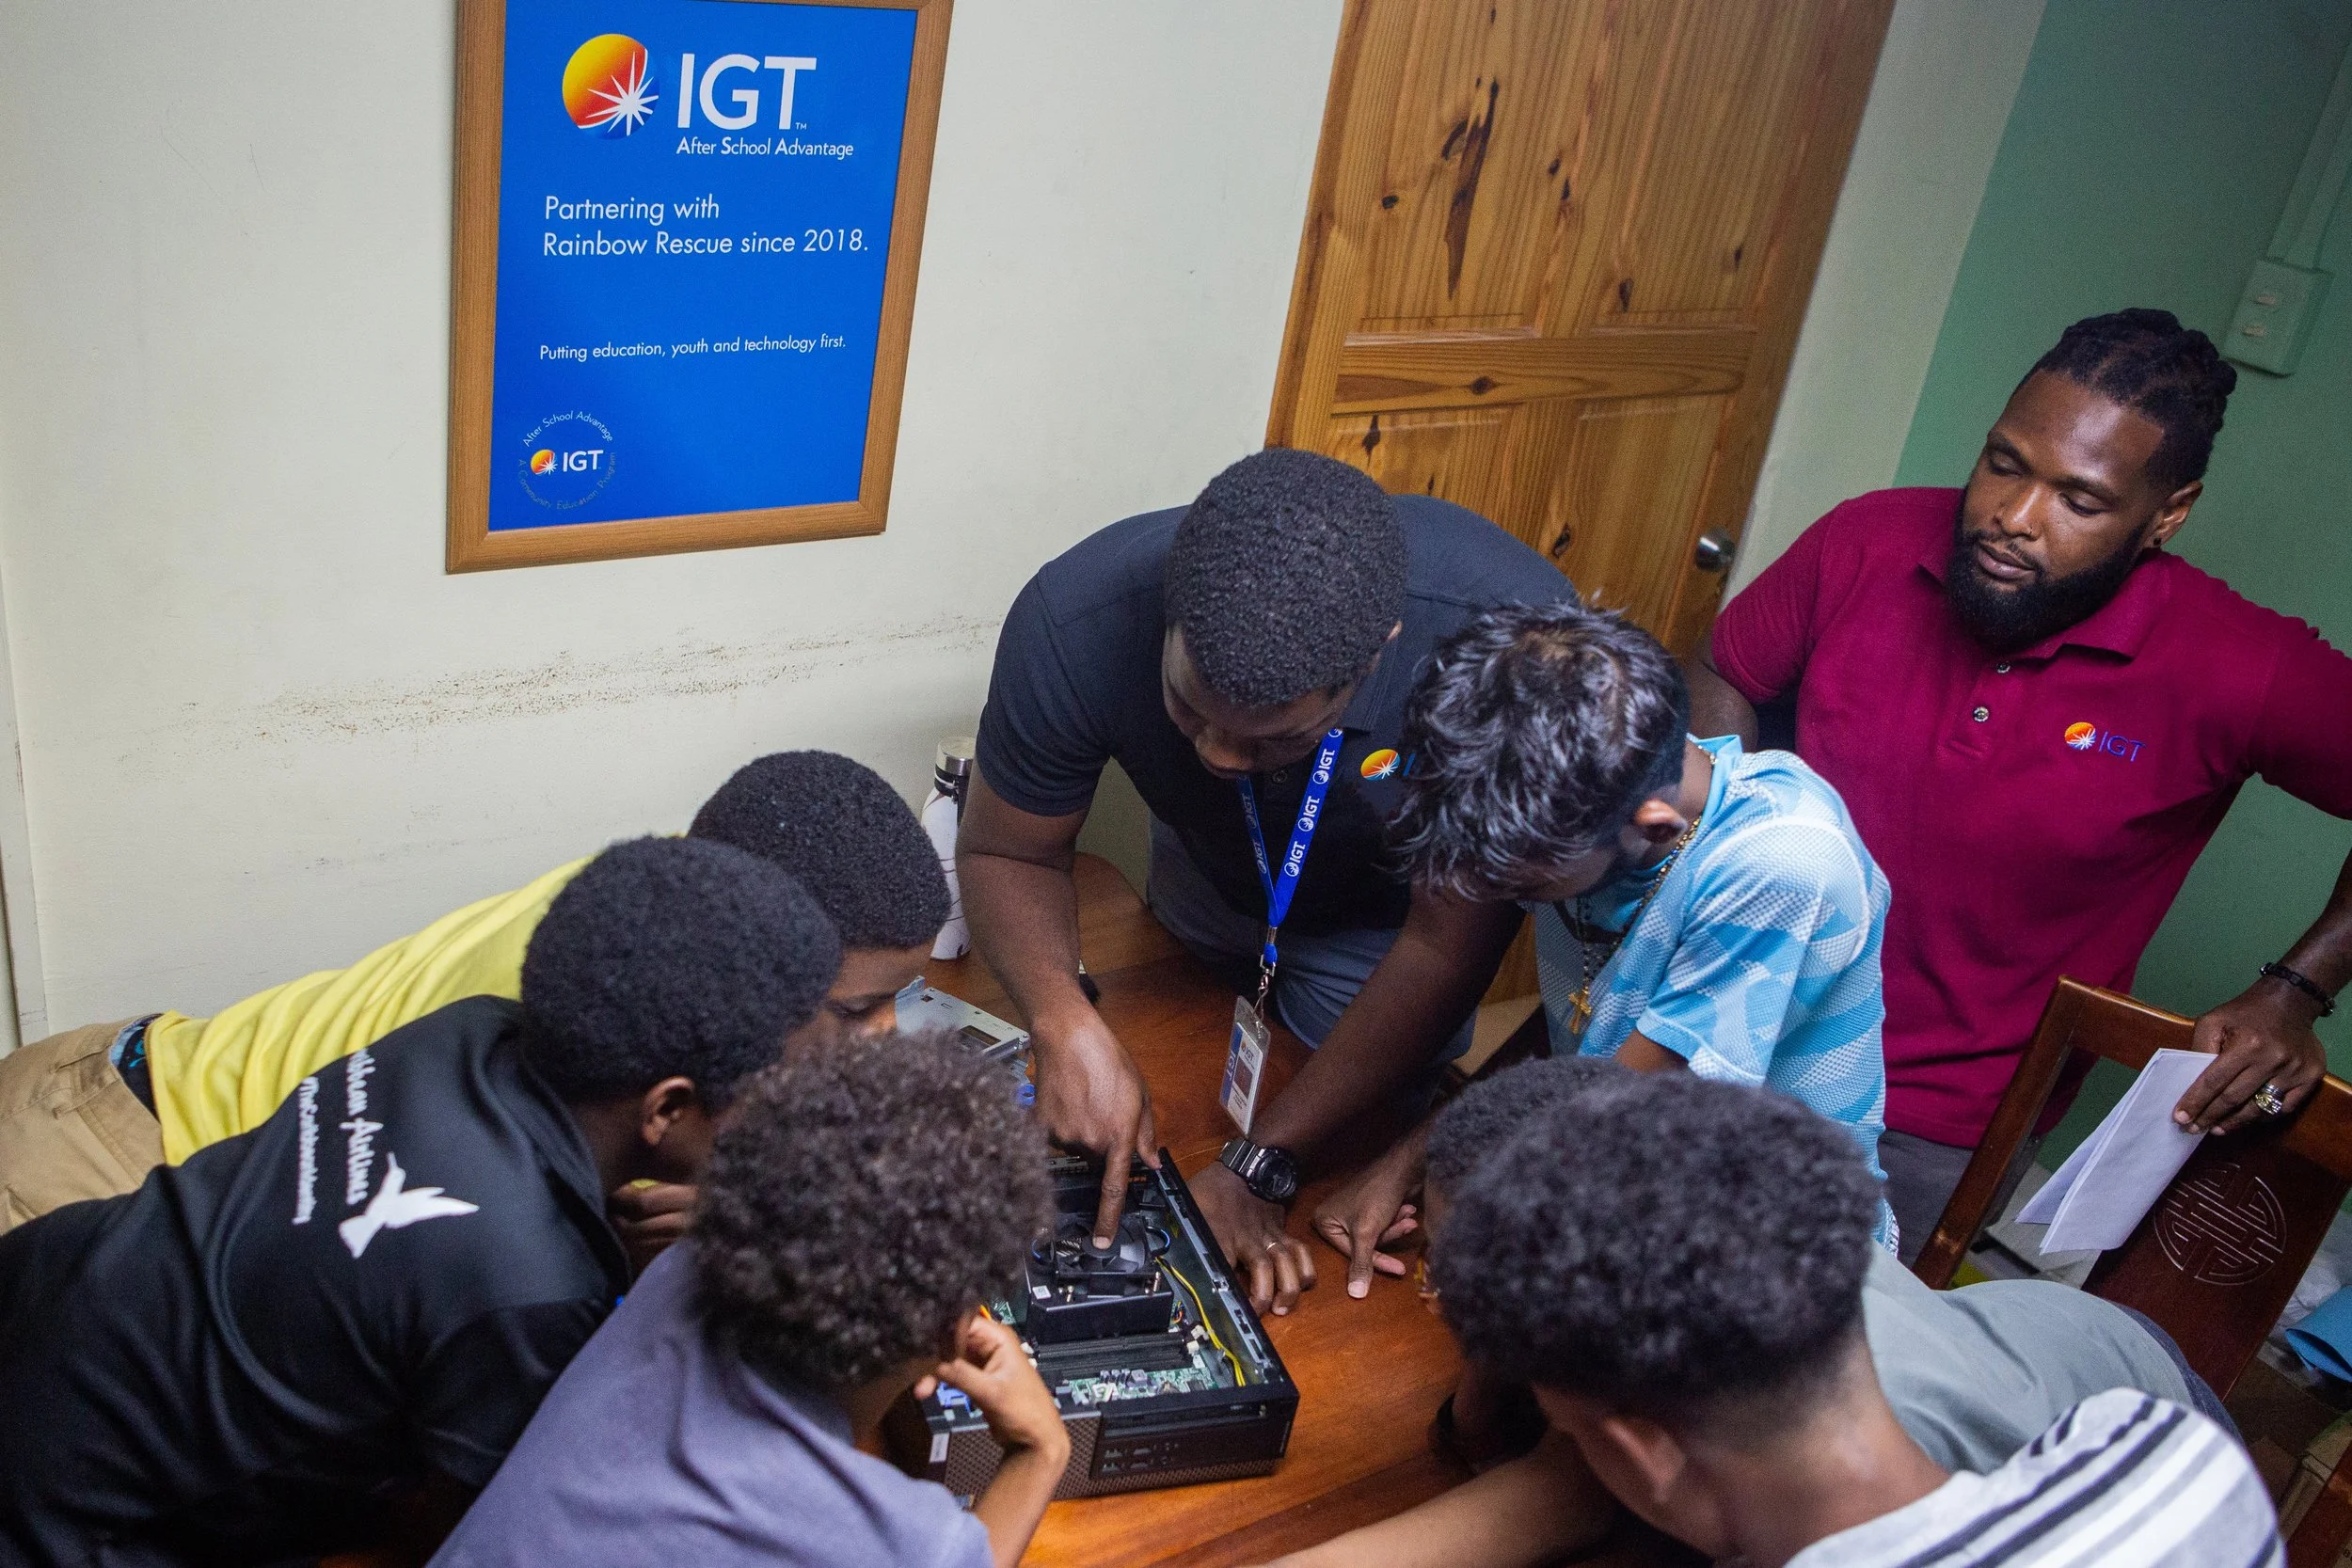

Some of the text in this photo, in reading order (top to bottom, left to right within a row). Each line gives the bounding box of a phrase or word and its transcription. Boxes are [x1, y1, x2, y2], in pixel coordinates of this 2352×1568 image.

[676, 53, 818, 130] IGT
[675, 135, 854, 161] After School Advantage
[544, 193, 720, 227] Partnering with
[543, 228, 869, 257] Rainbow Rescue since 2018.
[539, 332, 847, 363] Putting education, youth and technology first.
[522, 410, 613, 448] After School Advantage
[562, 449, 604, 473] IGT
[1317, 748, 1336, 771] IGT
[2098, 730, 2147, 763] IGT
[1303, 795, 1321, 818] IGT
[1289, 840, 1307, 864] IGT
